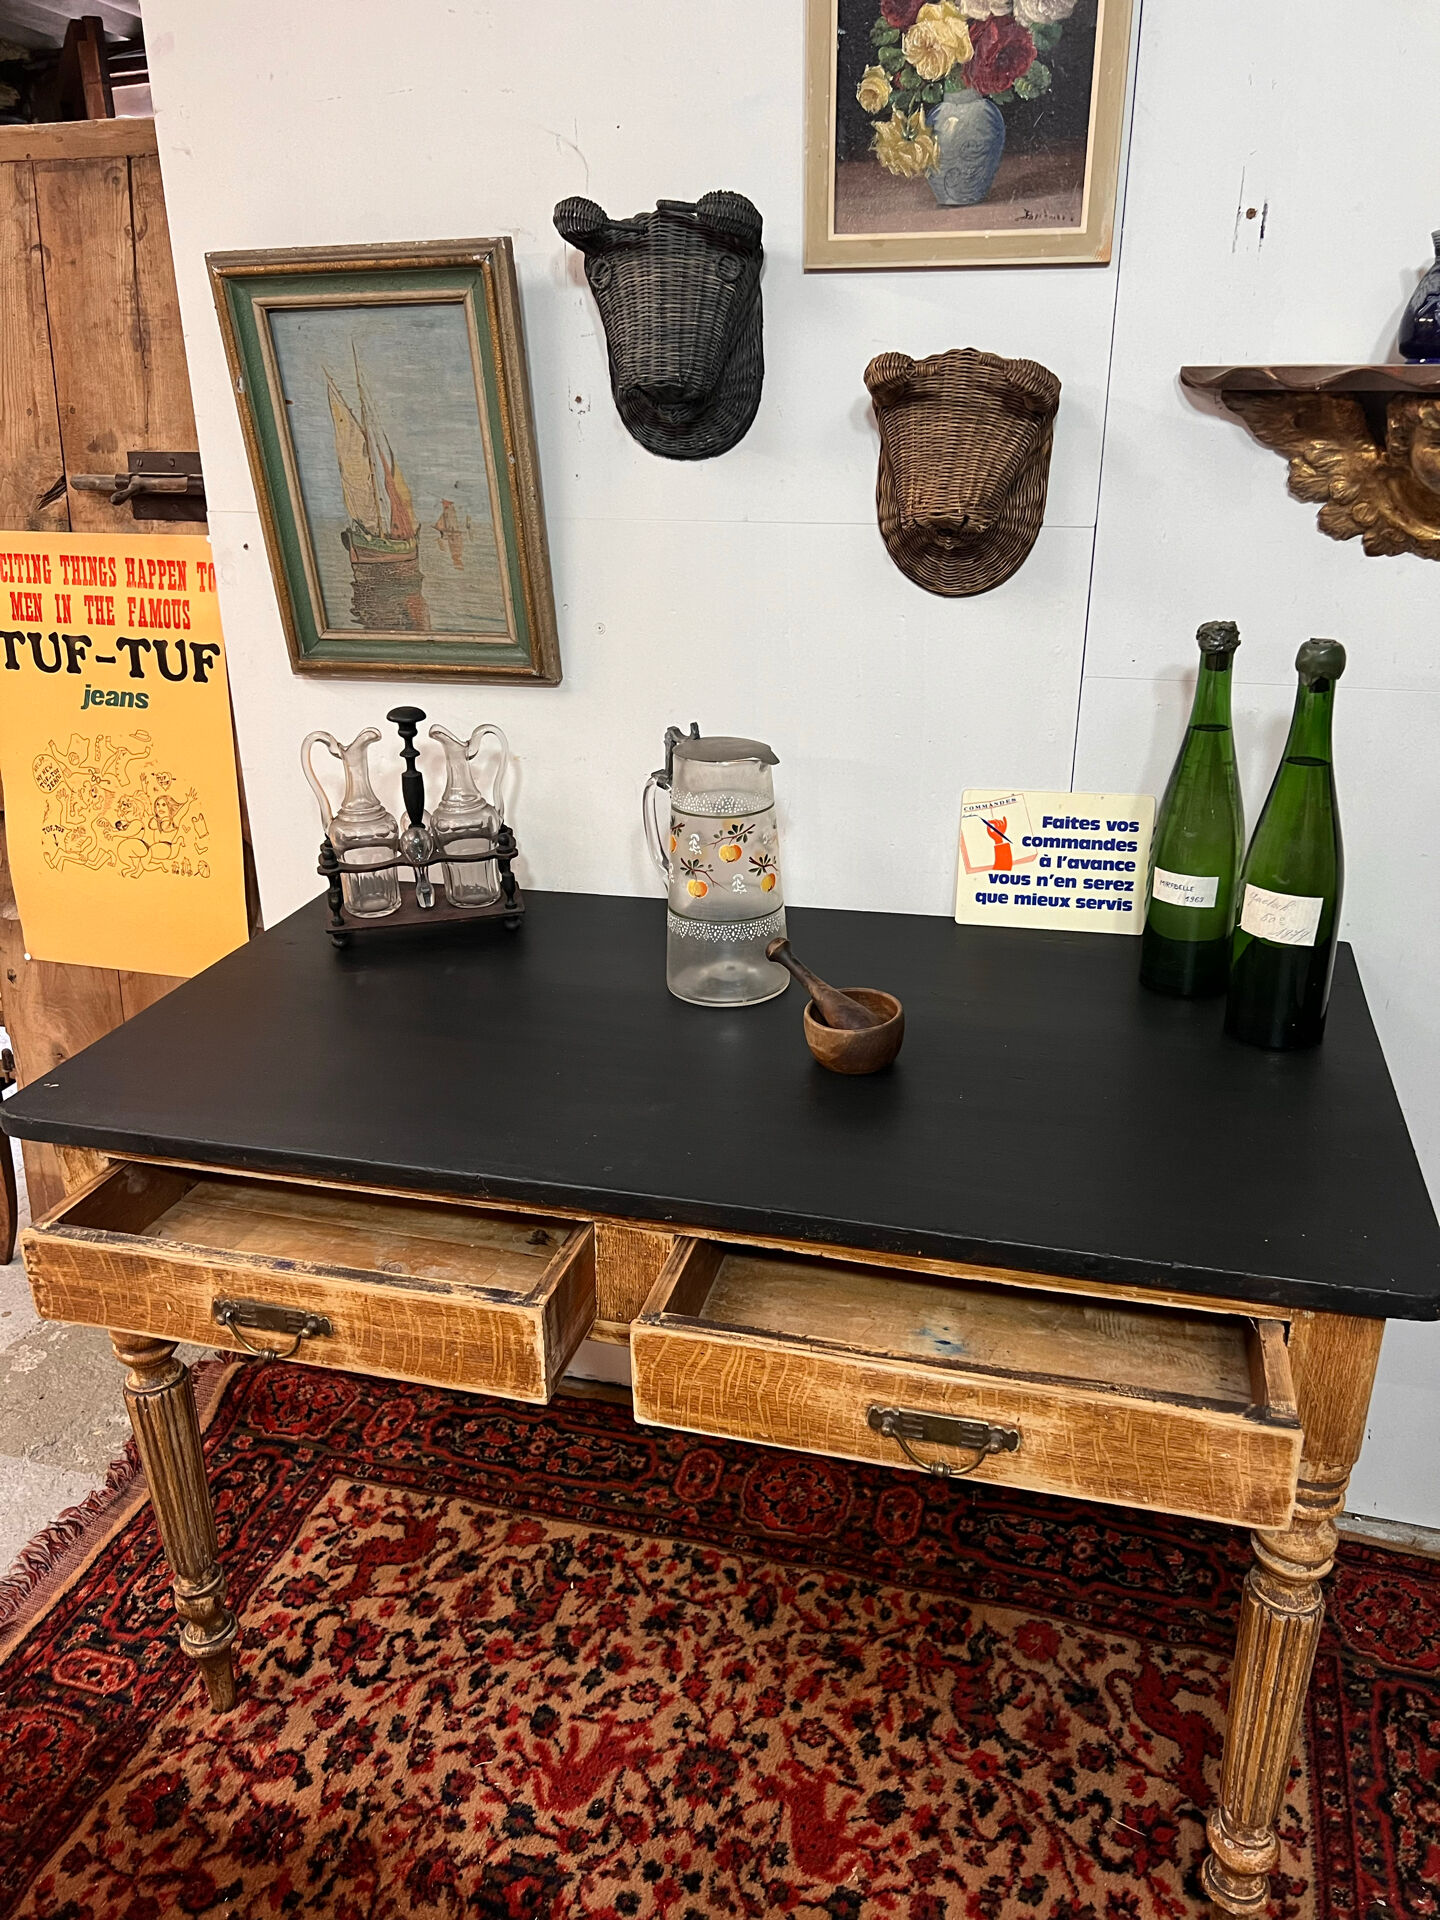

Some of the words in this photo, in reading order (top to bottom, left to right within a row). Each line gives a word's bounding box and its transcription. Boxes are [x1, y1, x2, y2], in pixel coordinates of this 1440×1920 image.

[59, 554, 117, 587] THINGS
[125, 557, 187, 591] HAPPEN
[196, 561, 217, 592] TO
[9, 591, 43, 622] MEN
[54, 593, 72, 624] IN
[83, 594, 116, 625] THE
[127, 596, 191, 630] FAMOUS
[0, 630, 221, 683] TUF-TUF
[80, 684, 150, 710] jeans
[963, 797, 1017, 811] COMMANDES
[1042, 815, 1101, 831] Faites
[1106, 820, 1140, 833] vos
[1021, 835, 1138, 853] commandes
[1039, 854, 1052, 868] à
[988, 873, 1031, 886] vous
[1083, 877, 1134, 892] serez
[975, 891, 1009, 905] que
[1013, 893, 1071, 909] mieux
[1075, 897, 1133, 912] servis
